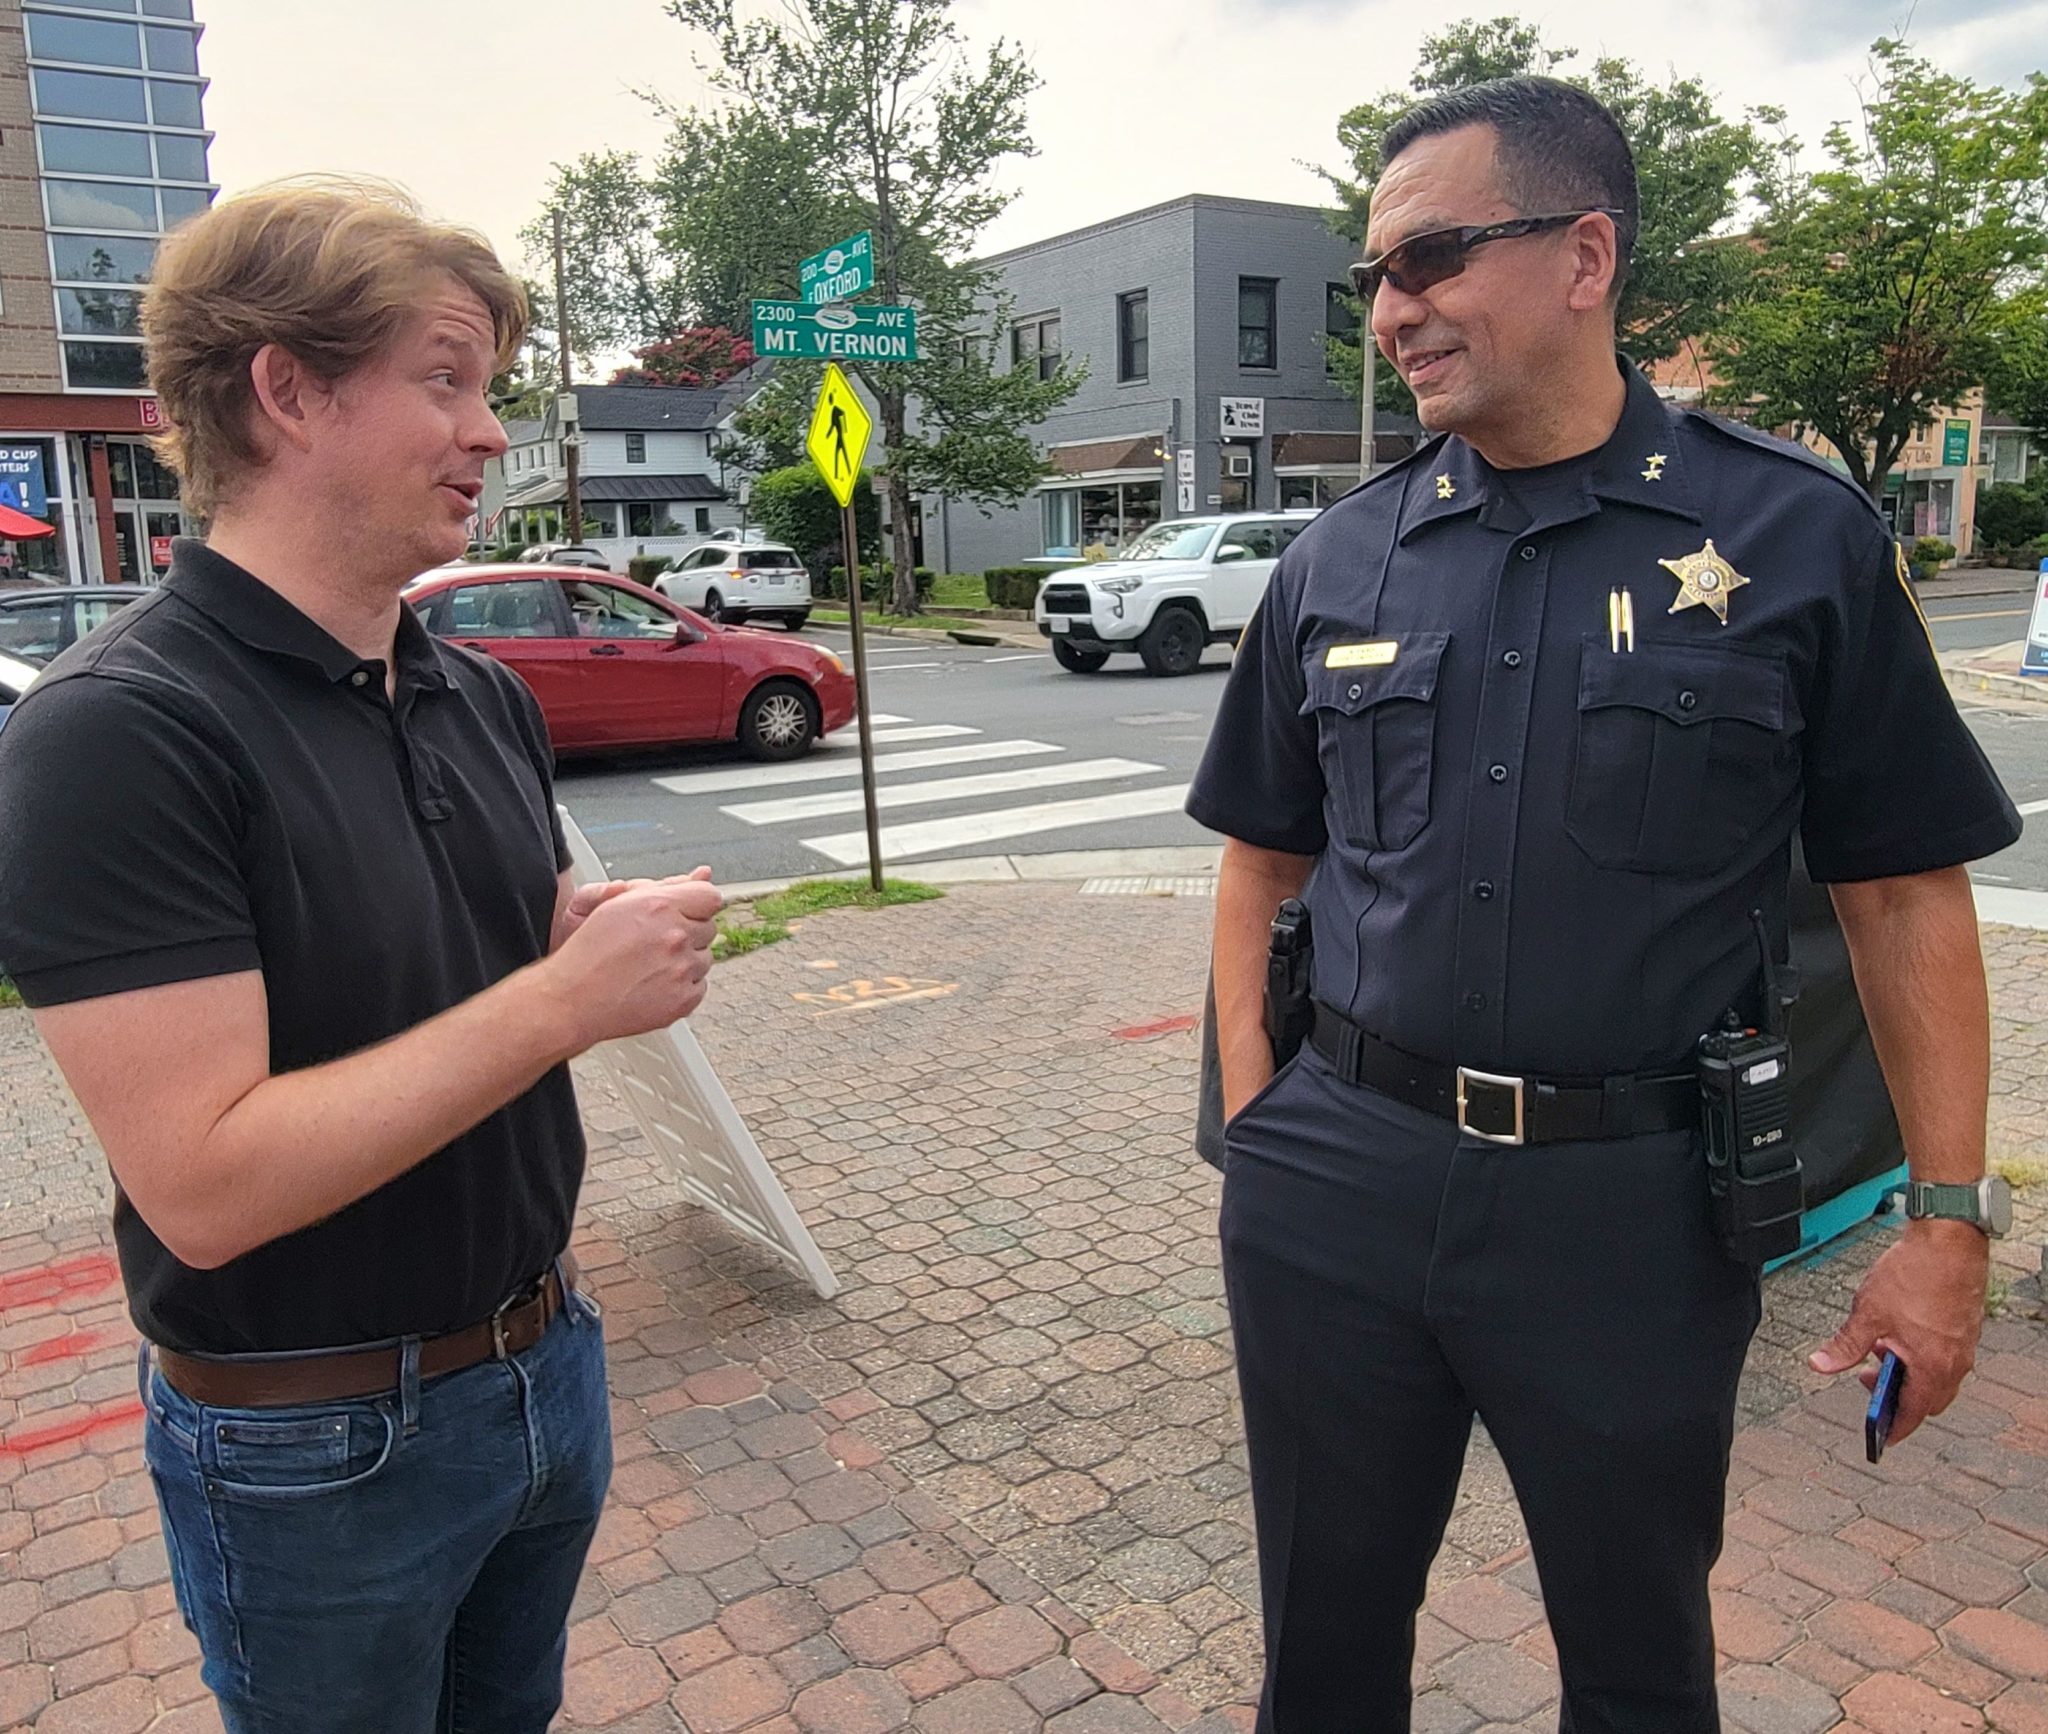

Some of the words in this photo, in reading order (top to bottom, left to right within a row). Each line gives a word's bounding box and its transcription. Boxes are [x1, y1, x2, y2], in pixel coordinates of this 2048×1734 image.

[851, 237, 868, 259] AVE
[814, 267, 861, 305] OXFORD
[756, 305, 795, 322] 2300
[876, 312, 907, 328] AVE
[764, 328, 802, 352] MT.
[813, 332, 906, 356] VERNON
[12, 450, 38, 460] CUP
